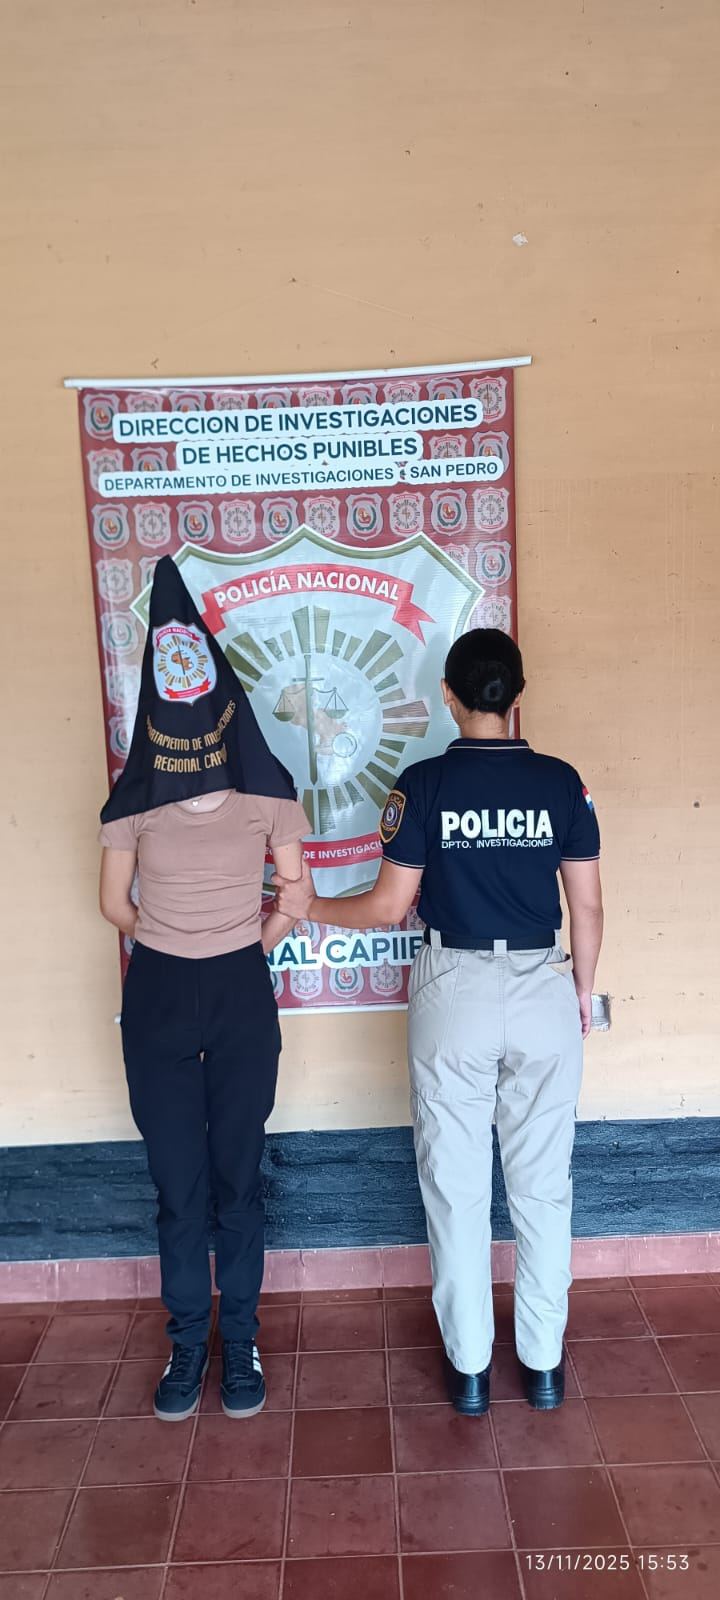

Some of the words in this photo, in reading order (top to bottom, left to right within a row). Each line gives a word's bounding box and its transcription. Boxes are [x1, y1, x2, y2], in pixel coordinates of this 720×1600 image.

[119, 416, 239, 437] DIRECCION
[245, 415, 272, 432] DE
[279, 404, 478, 431] INVESTIGACIONES
[182, 447, 210, 465] DE
[216, 443, 308, 463] HECHOS
[313, 437, 418, 460] PUNIBLES
[104, 475, 227, 491] DEPARTAMENTO
[231, 474, 252, 487] DE
[256, 468, 394, 486] INVESTIGACIONES
[410, 465, 442, 479] SAN
[446, 462, 498, 477] PEDRO
[213, 571, 292, 608] POLICÍA
[297, 571, 400, 601] NACIONAL
[192, 738, 203, 751] DE
[153, 754, 202, 773] REGIONAL
[441, 809, 553, 840] POLICIA
[303, 850, 316, 860] DE
[441, 840, 472, 849] DPTO.
[477, 838, 553, 848] INVESTIGACIONES
